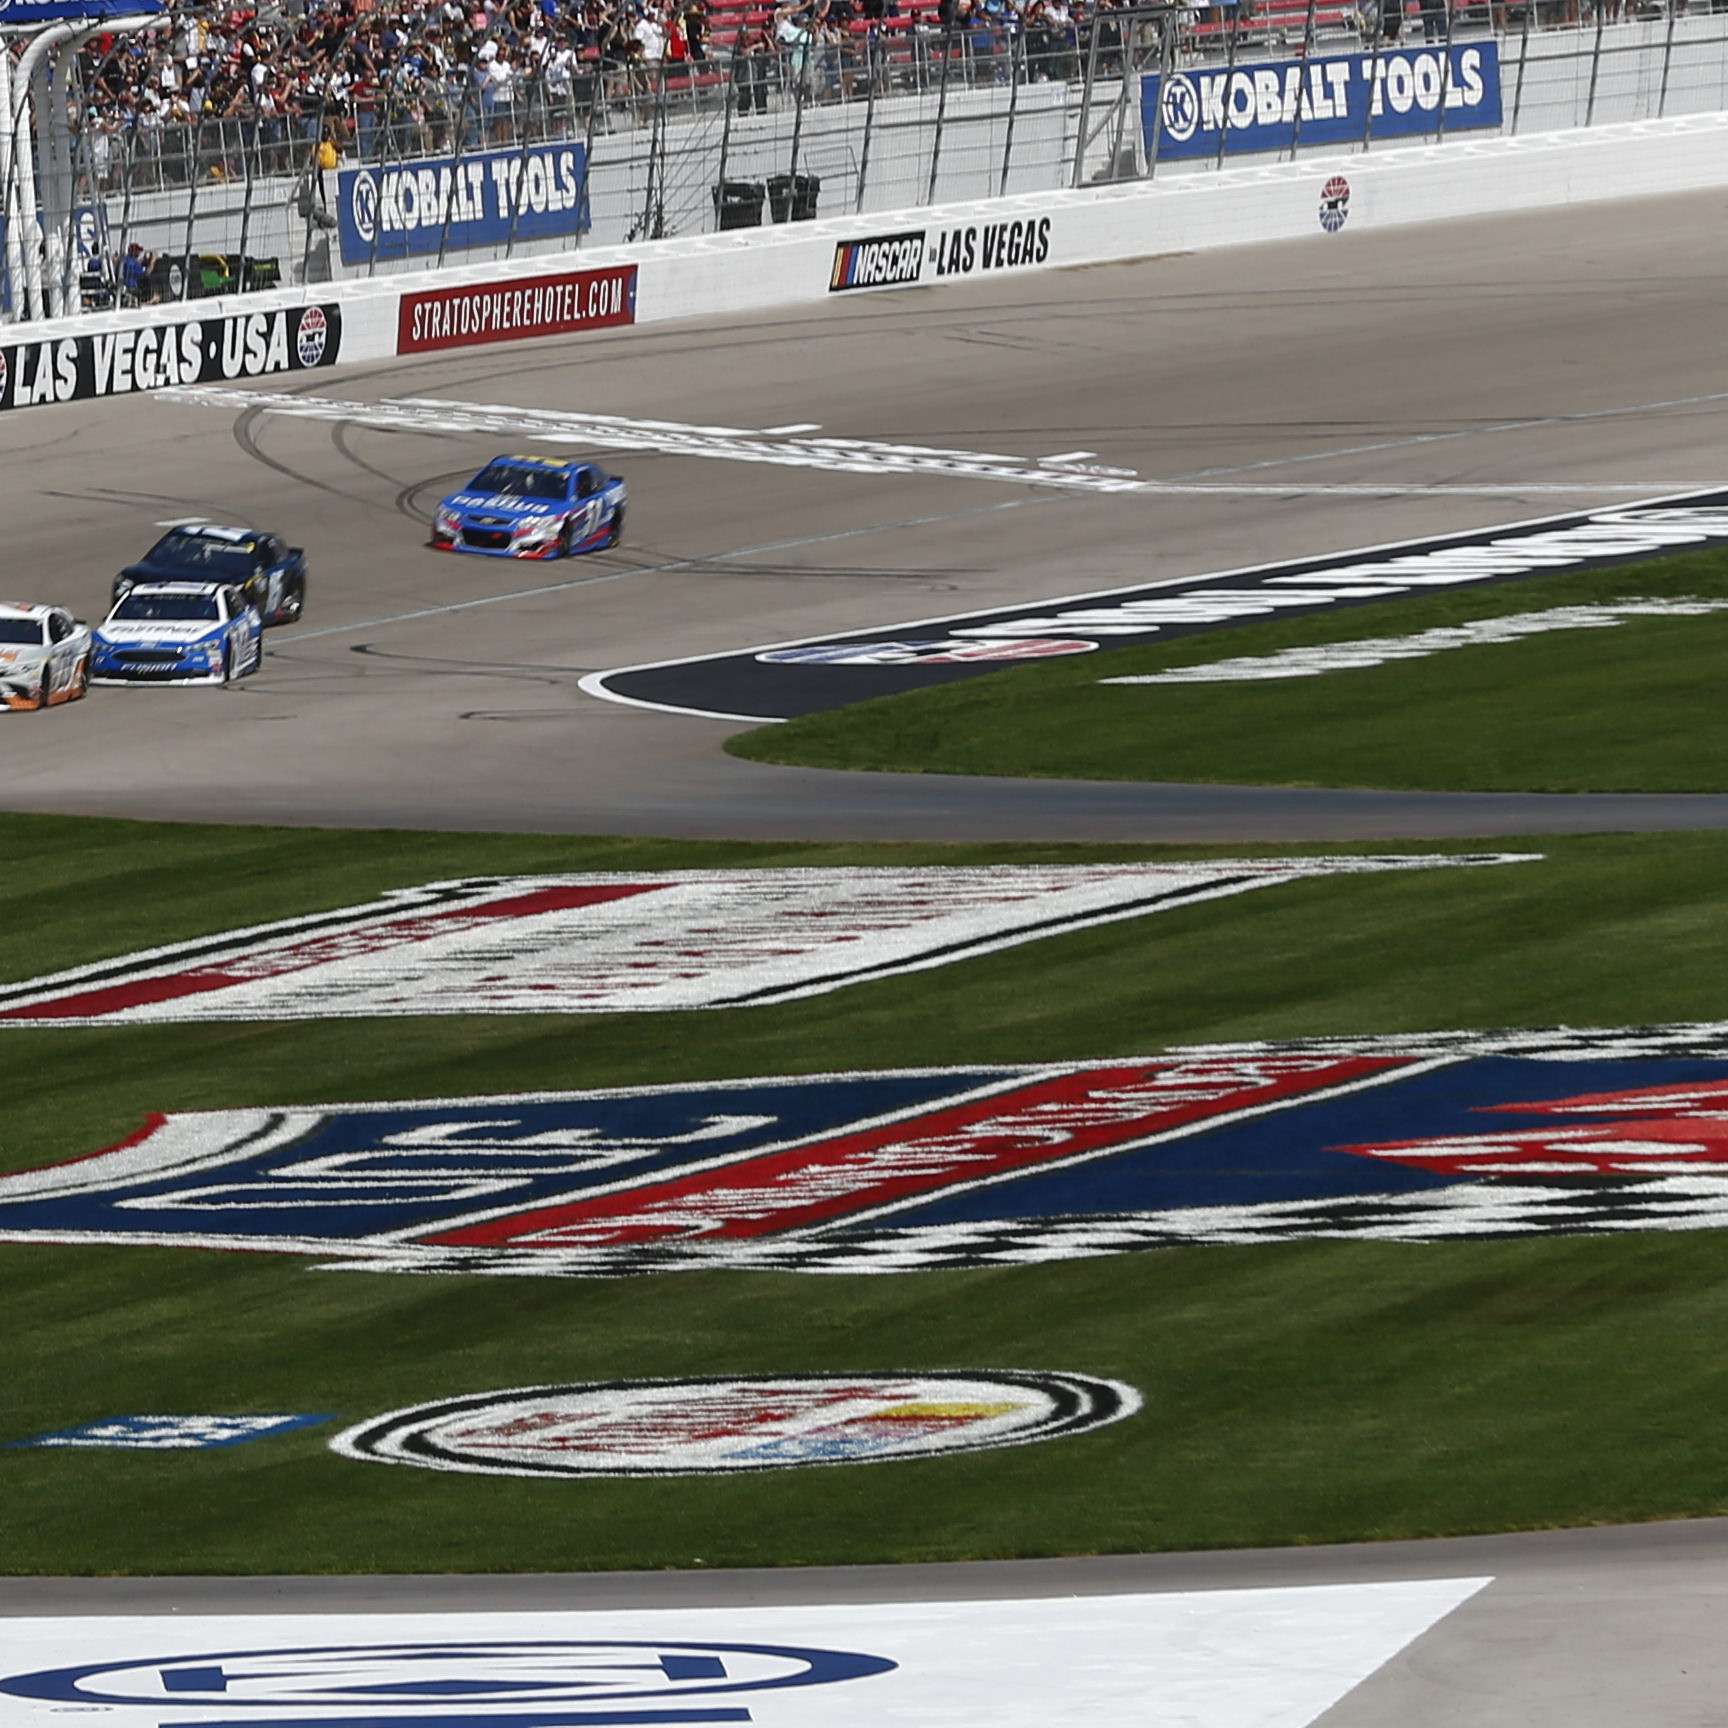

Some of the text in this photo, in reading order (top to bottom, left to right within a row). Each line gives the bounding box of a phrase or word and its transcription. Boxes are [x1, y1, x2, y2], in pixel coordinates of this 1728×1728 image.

[1201, 63, 1350, 133] KOBALT
[1370, 47, 1484, 115] TOOLS
[380, 161, 484, 232] KOBALT
[492, 151, 577, 218] TOOLS
[854, 216, 1051, 284] NASCAR LAS VEGAS
[411, 279, 623, 342] STRATOSPHEREHOTEL.COM
[13, 311, 289, 407] LAS VEGAS USA
